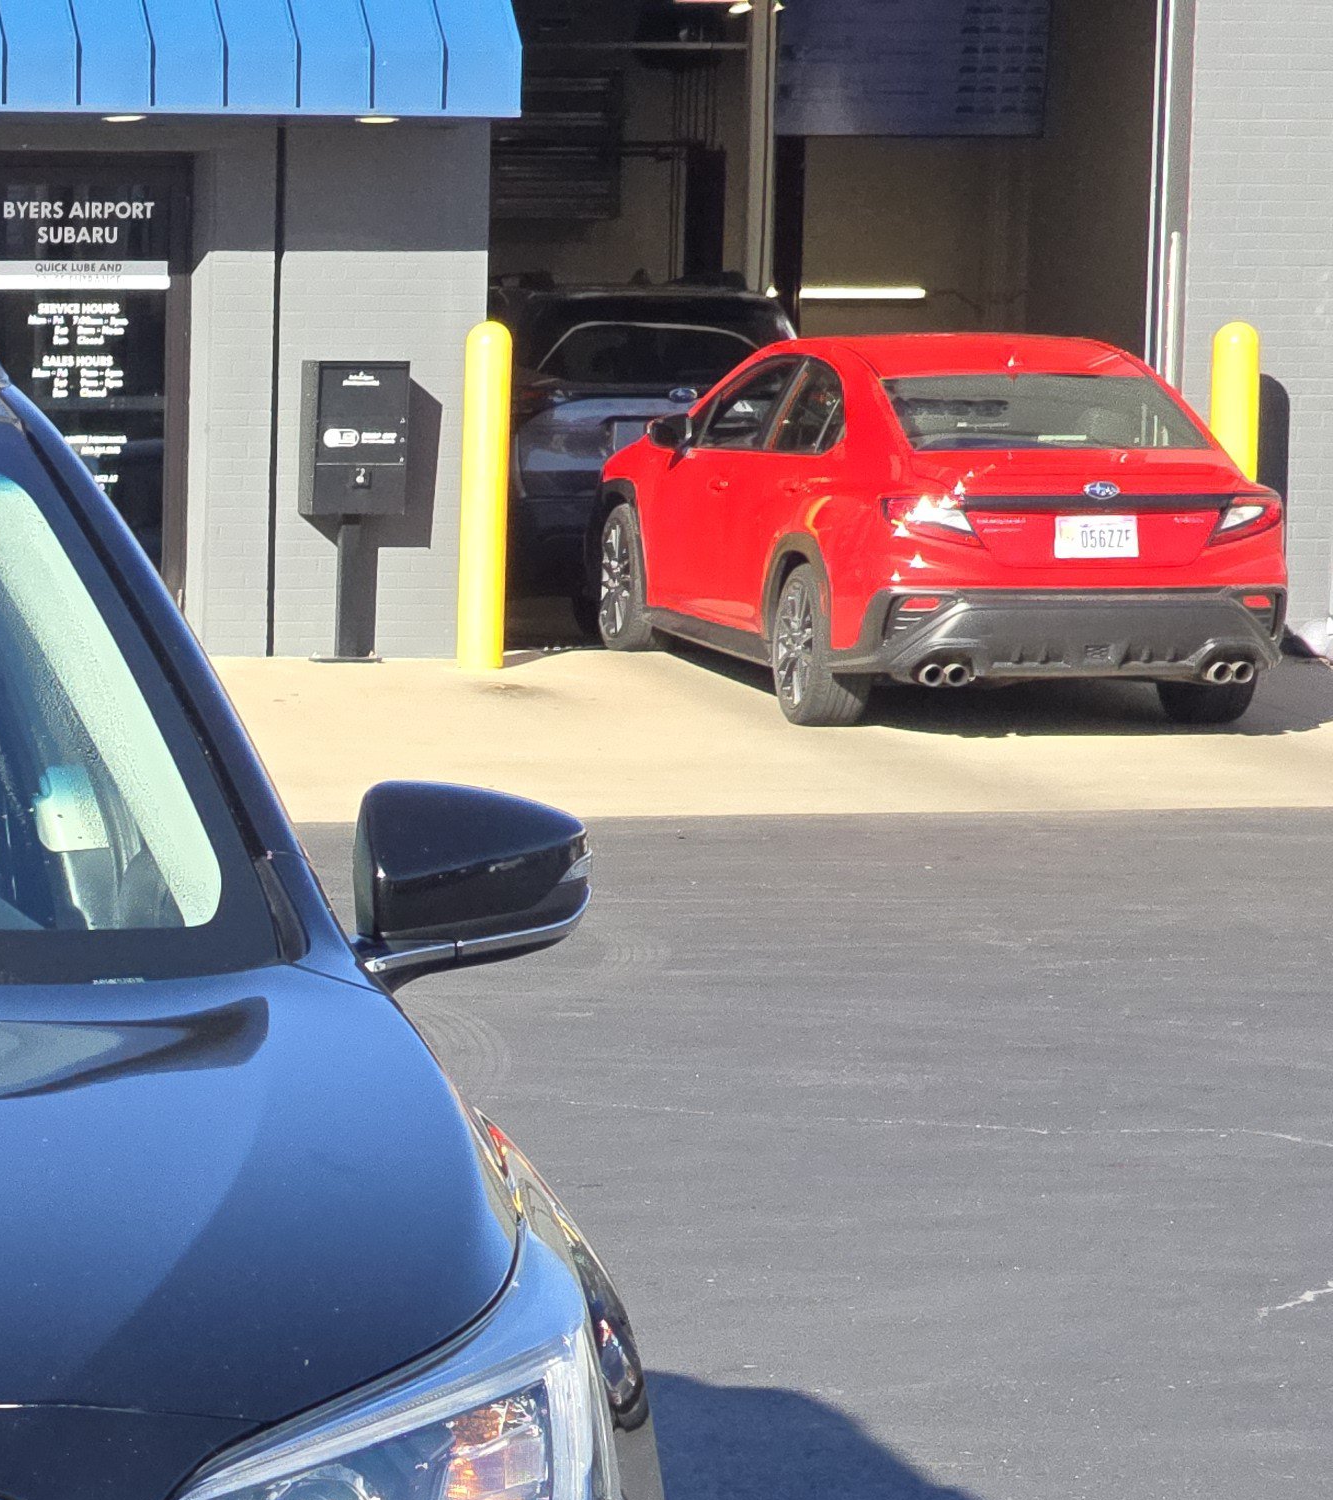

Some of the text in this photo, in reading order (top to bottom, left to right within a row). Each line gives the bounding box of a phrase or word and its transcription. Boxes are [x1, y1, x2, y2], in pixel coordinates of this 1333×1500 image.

[3, 201, 155, 219] BYERS AIRPORT
[37, 226, 118, 244] SUBARU
[35, 262, 122, 273] QUICK LUBE AND
[42, 355, 114, 368] SALES HOURS
